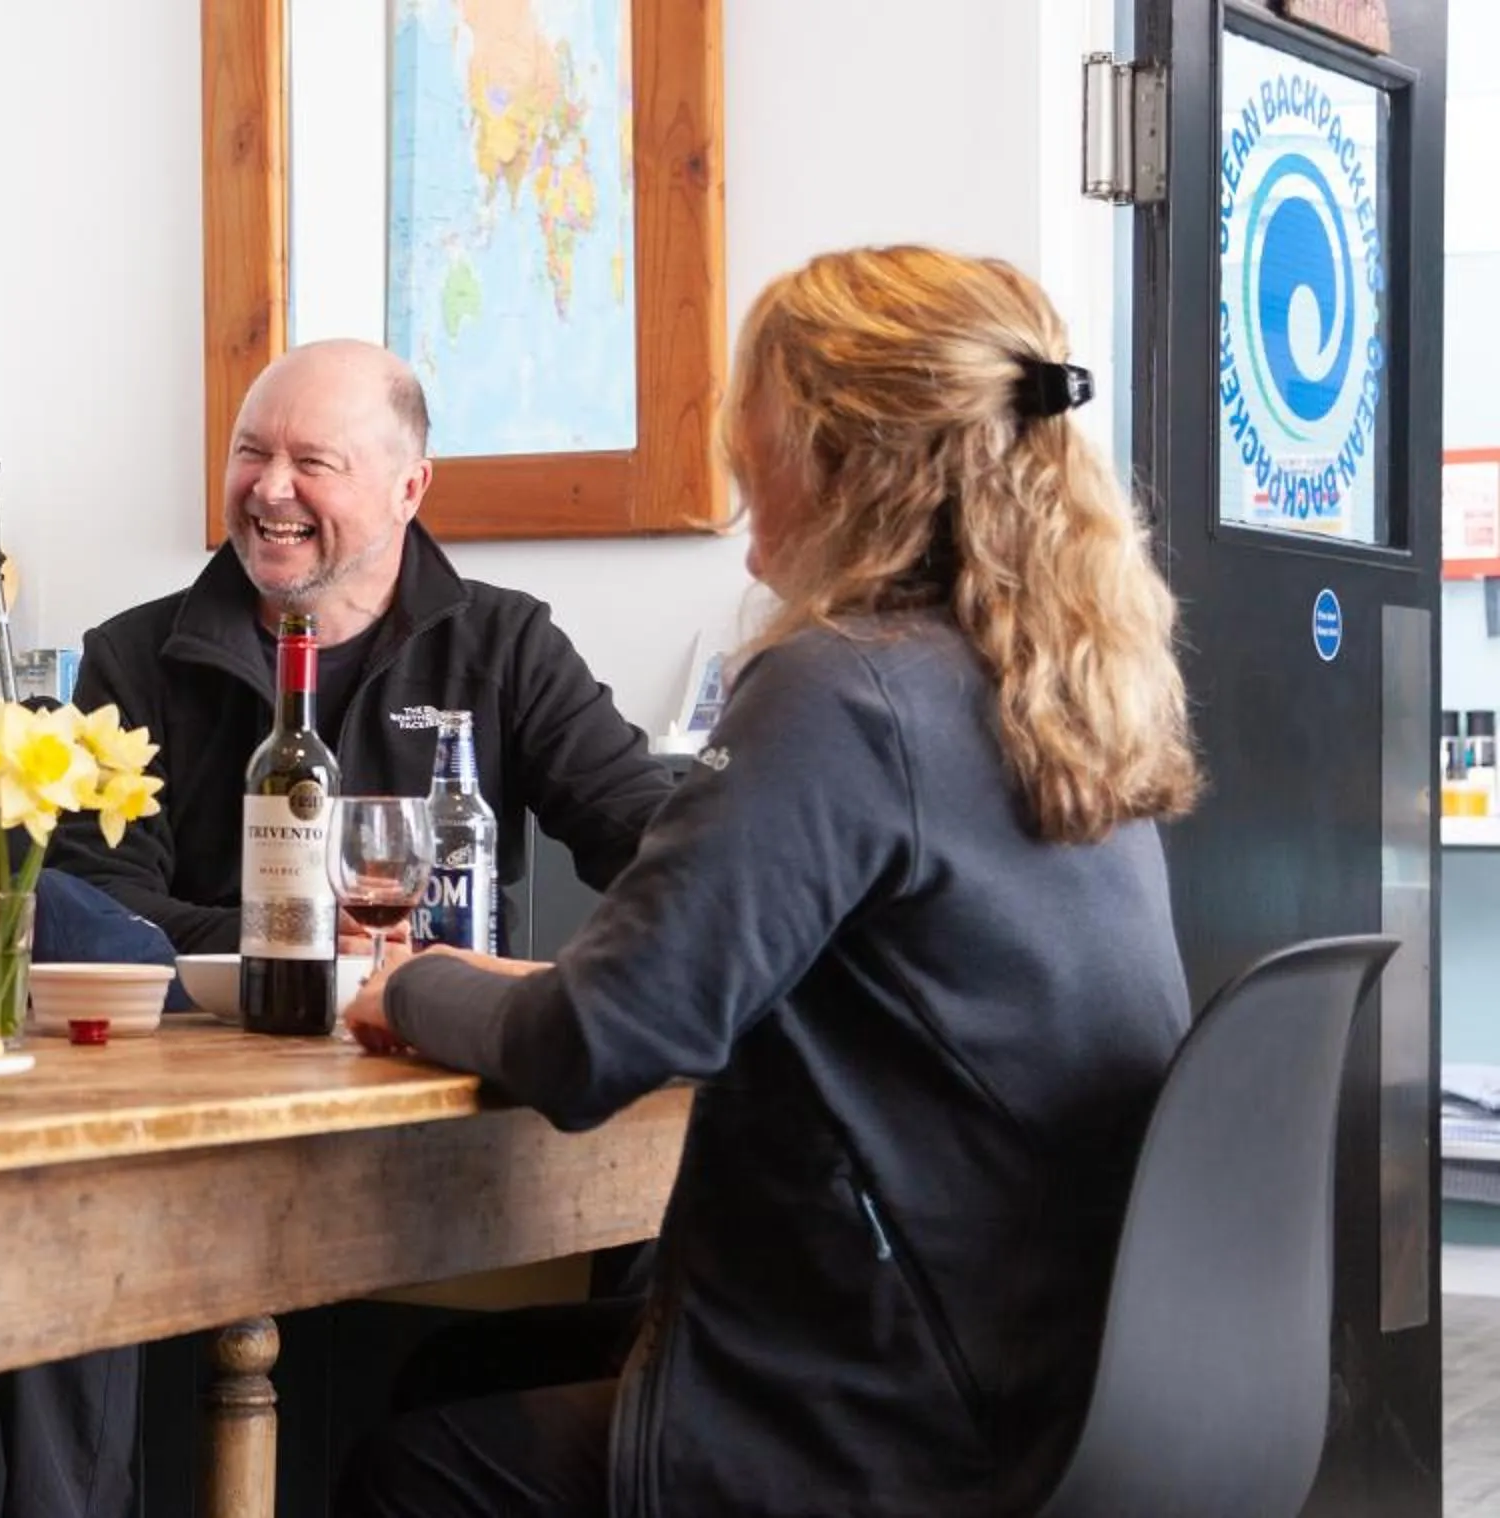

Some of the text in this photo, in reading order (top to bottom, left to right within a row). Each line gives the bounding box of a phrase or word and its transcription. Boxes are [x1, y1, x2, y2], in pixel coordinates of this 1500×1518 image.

[1260, 74, 1385, 294] BACKPACKERS
[1337, 335, 1384, 488] OCEAN
[249, 825, 323, 840] TRIVENTO
